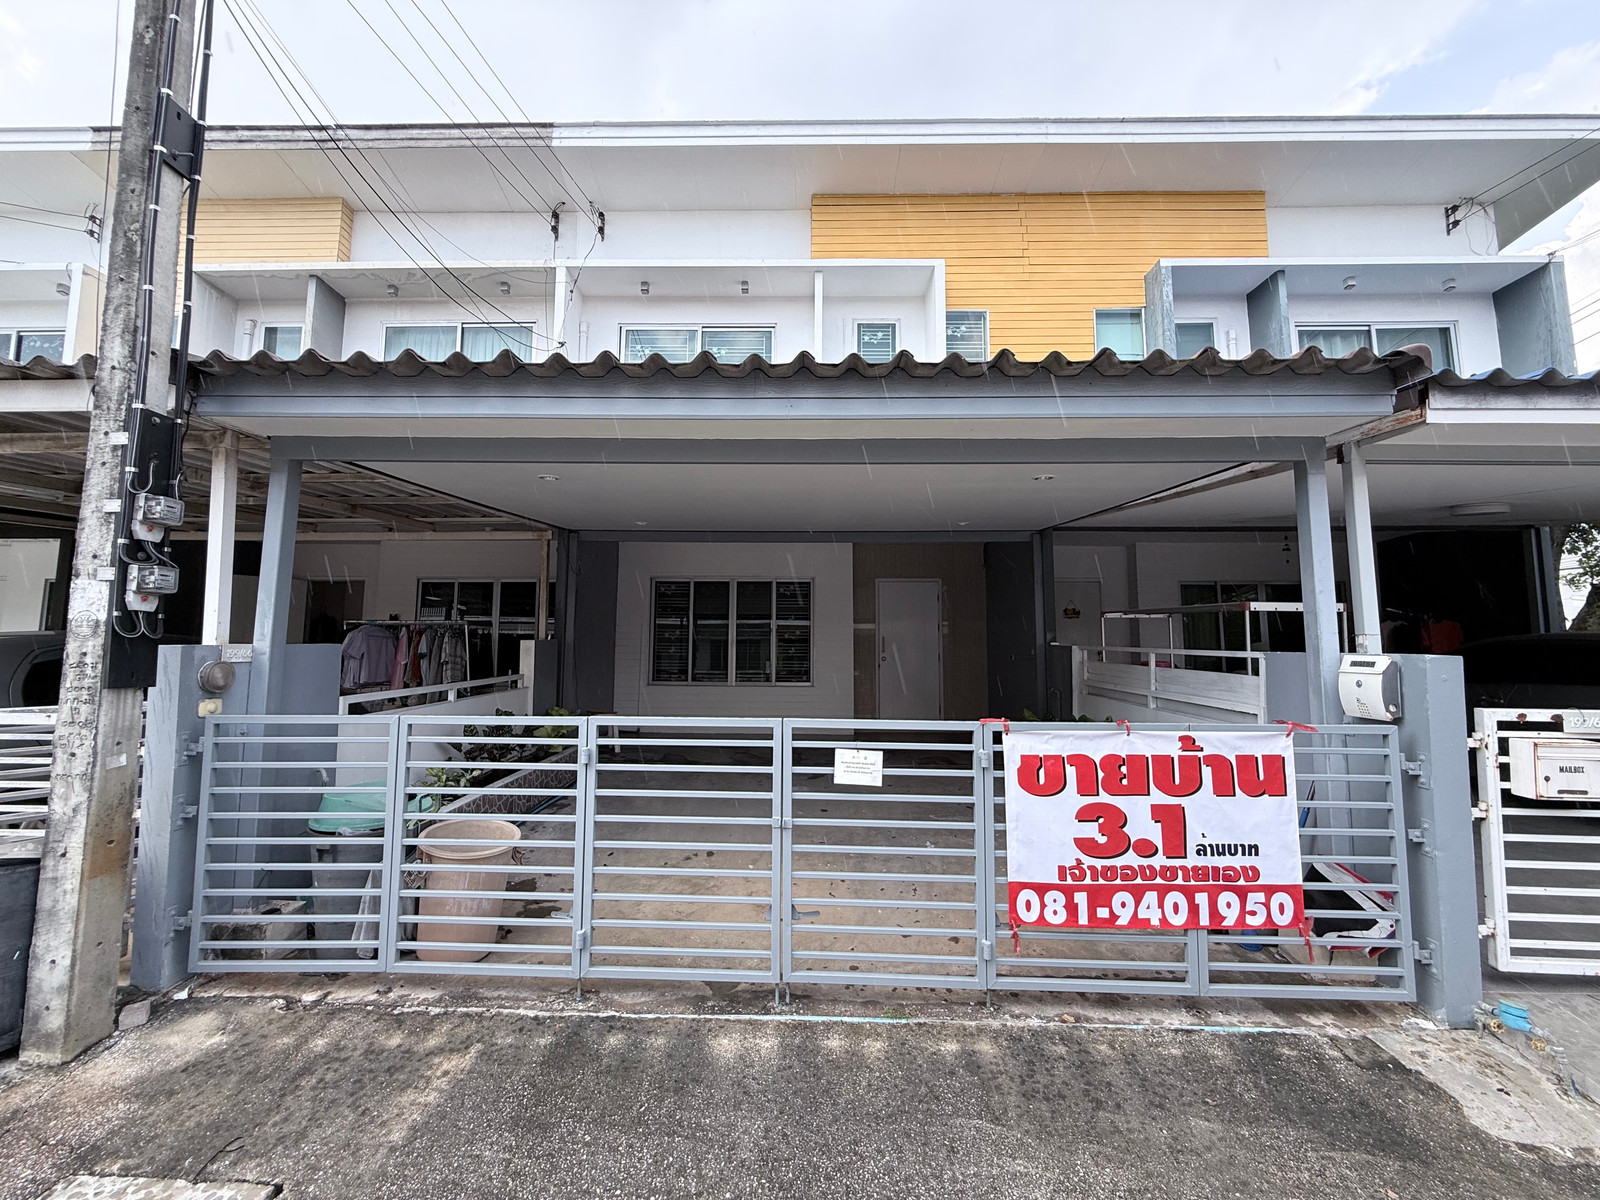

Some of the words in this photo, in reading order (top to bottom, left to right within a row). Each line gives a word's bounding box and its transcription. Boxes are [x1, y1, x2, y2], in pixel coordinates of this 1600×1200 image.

[1017, 735, 1287, 797] ขายบ้าน
[1559, 766, 1584, 774] MAILBOX
[1073, 802, 1187, 859] 3.1
[1195, 833, 1259, 857] ล้านบาท
[1058, 858, 1260, 883] เจ้าของขายเอง
[1016, 889, 1294, 927] 081-9401950
